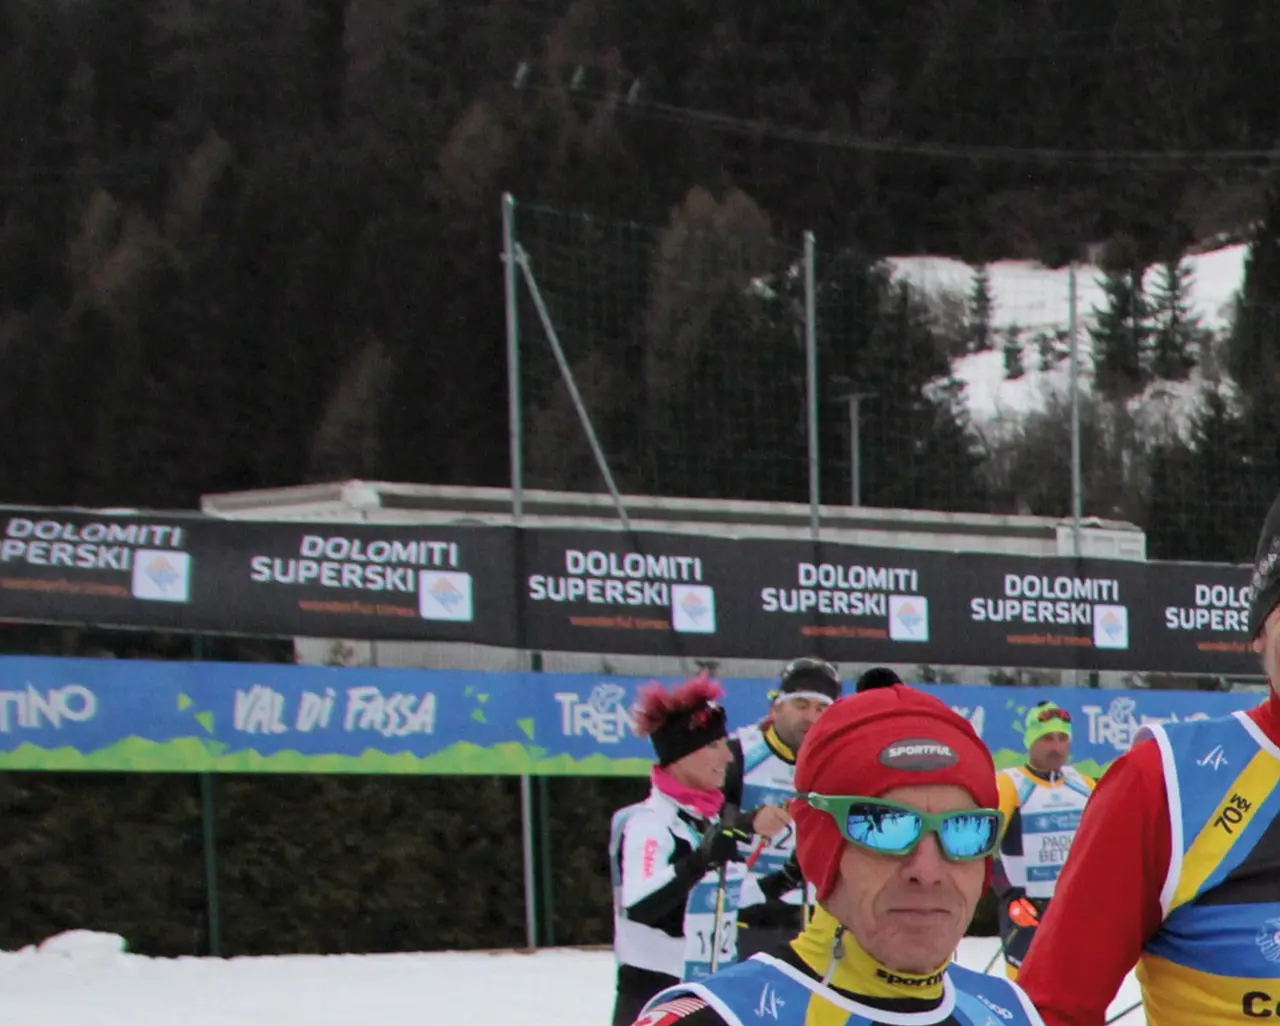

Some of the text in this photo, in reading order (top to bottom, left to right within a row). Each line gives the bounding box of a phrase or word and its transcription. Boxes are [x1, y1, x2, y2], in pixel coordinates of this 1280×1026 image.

[6, 518, 182, 547] DOLOMITI
[301, 535, 459, 567] DOLOMITI
[565, 549, 702, 581] DOLOMITI
[250, 556, 416, 592] SUPERSKI
[799, 563, 917, 592] DOLOMITI
[1004, 574, 1119, 602] DOLOMITI
[528, 574, 669, 606] SUPERSKI
[761, 588, 886, 616] SUPERSKI
[970, 598, 1091, 625] SUPERSKI
[234, 685, 286, 734] VAL
[345, 686, 436, 738] FASSA
[888, 744, 952, 758] SPORTFUL
